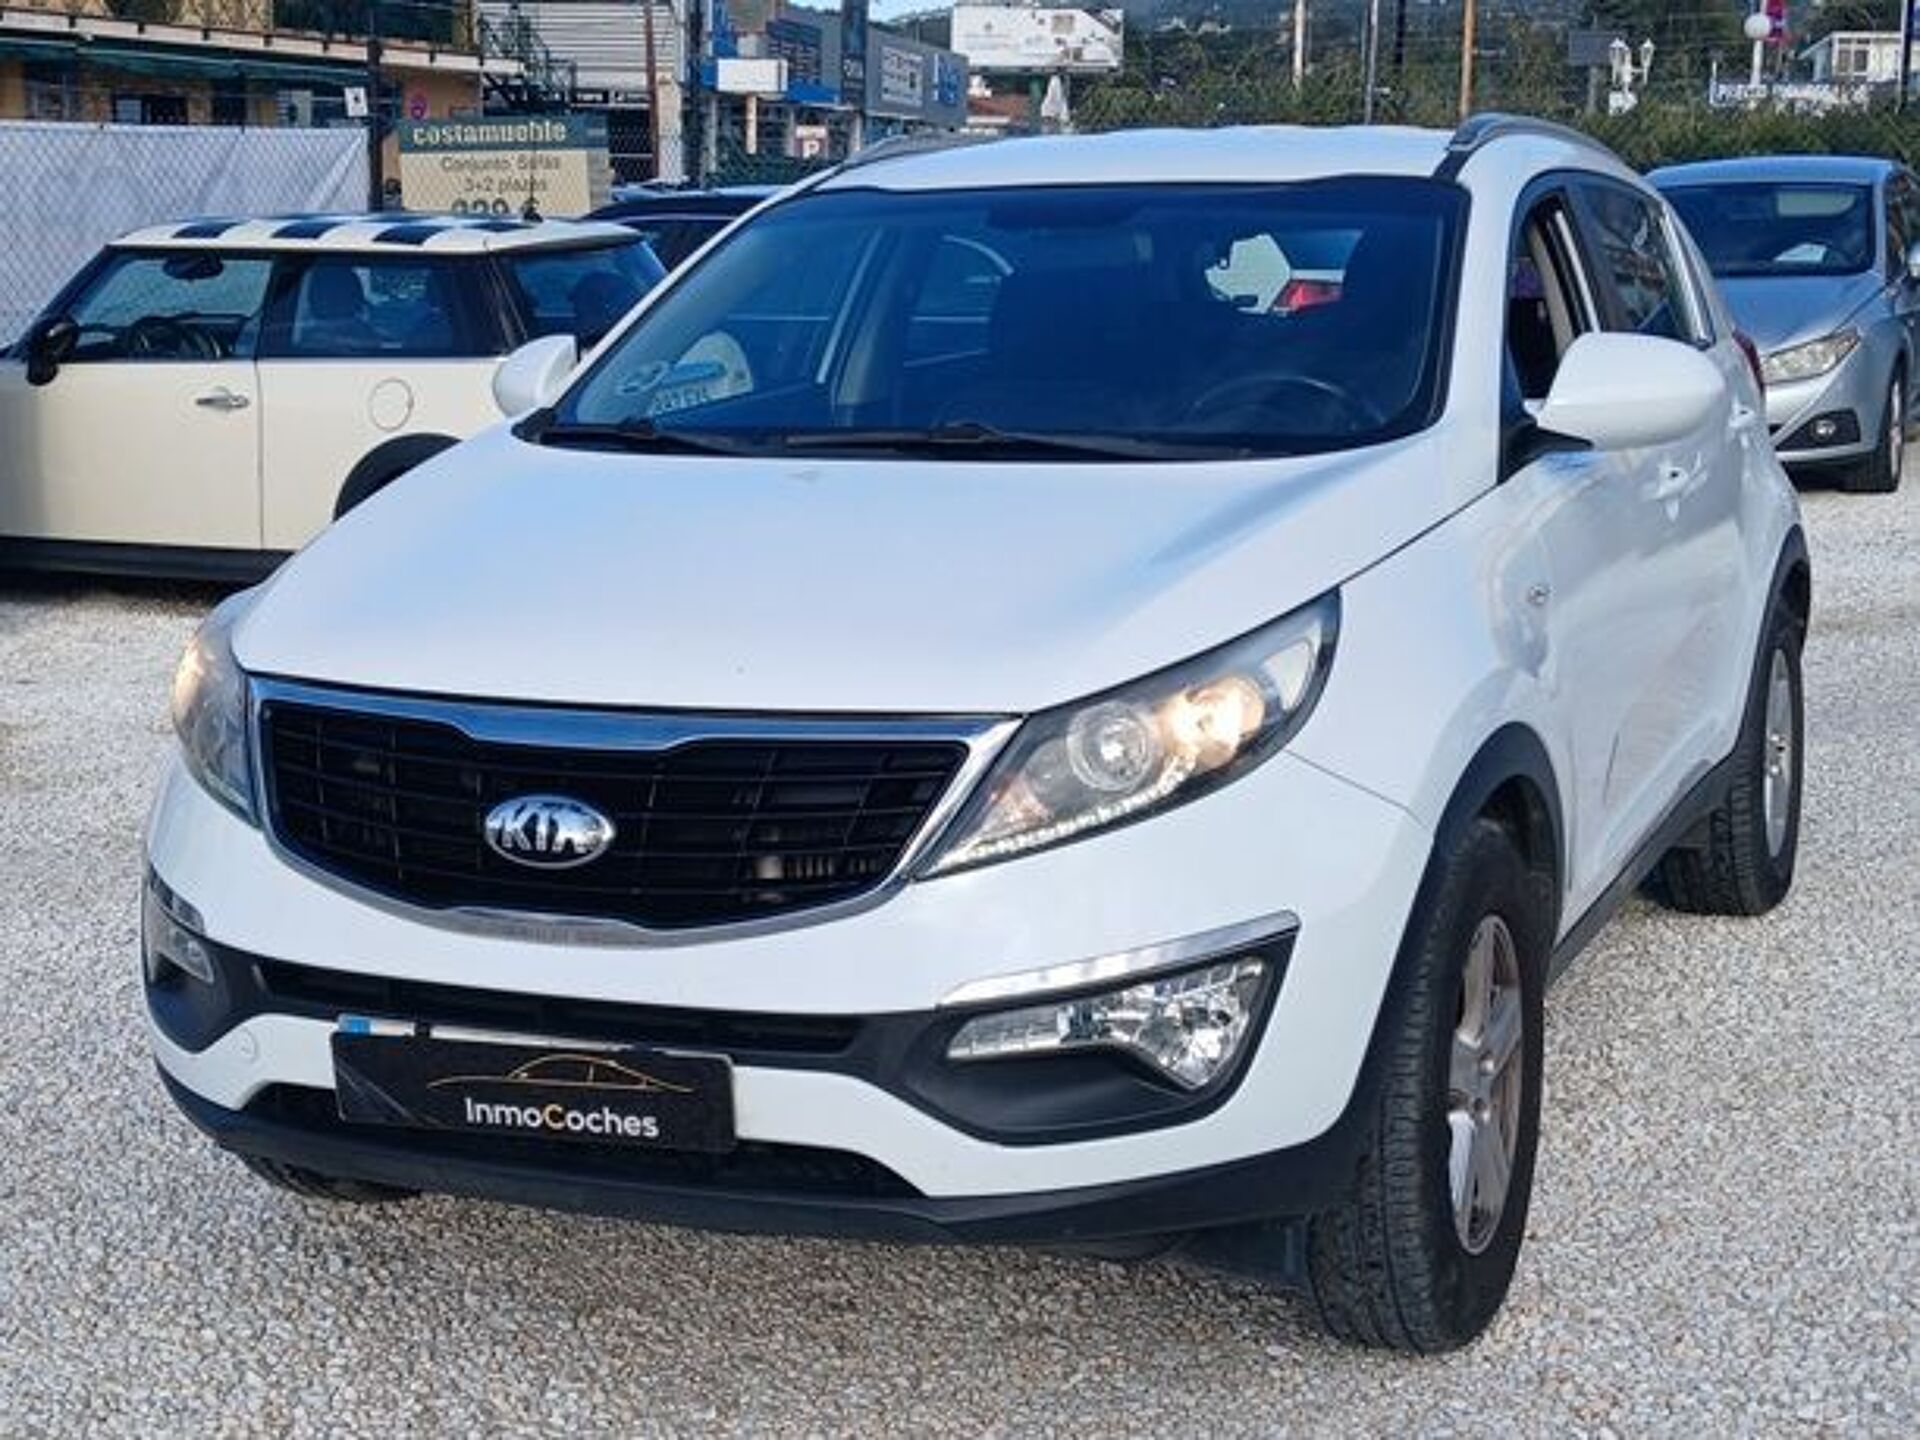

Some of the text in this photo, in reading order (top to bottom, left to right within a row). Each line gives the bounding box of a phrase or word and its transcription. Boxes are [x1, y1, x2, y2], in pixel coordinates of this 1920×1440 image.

[413, 120, 567, 144] costamueble
[487, 798, 602, 856] KIA
[466, 1097, 660, 1138] InmoCoches
